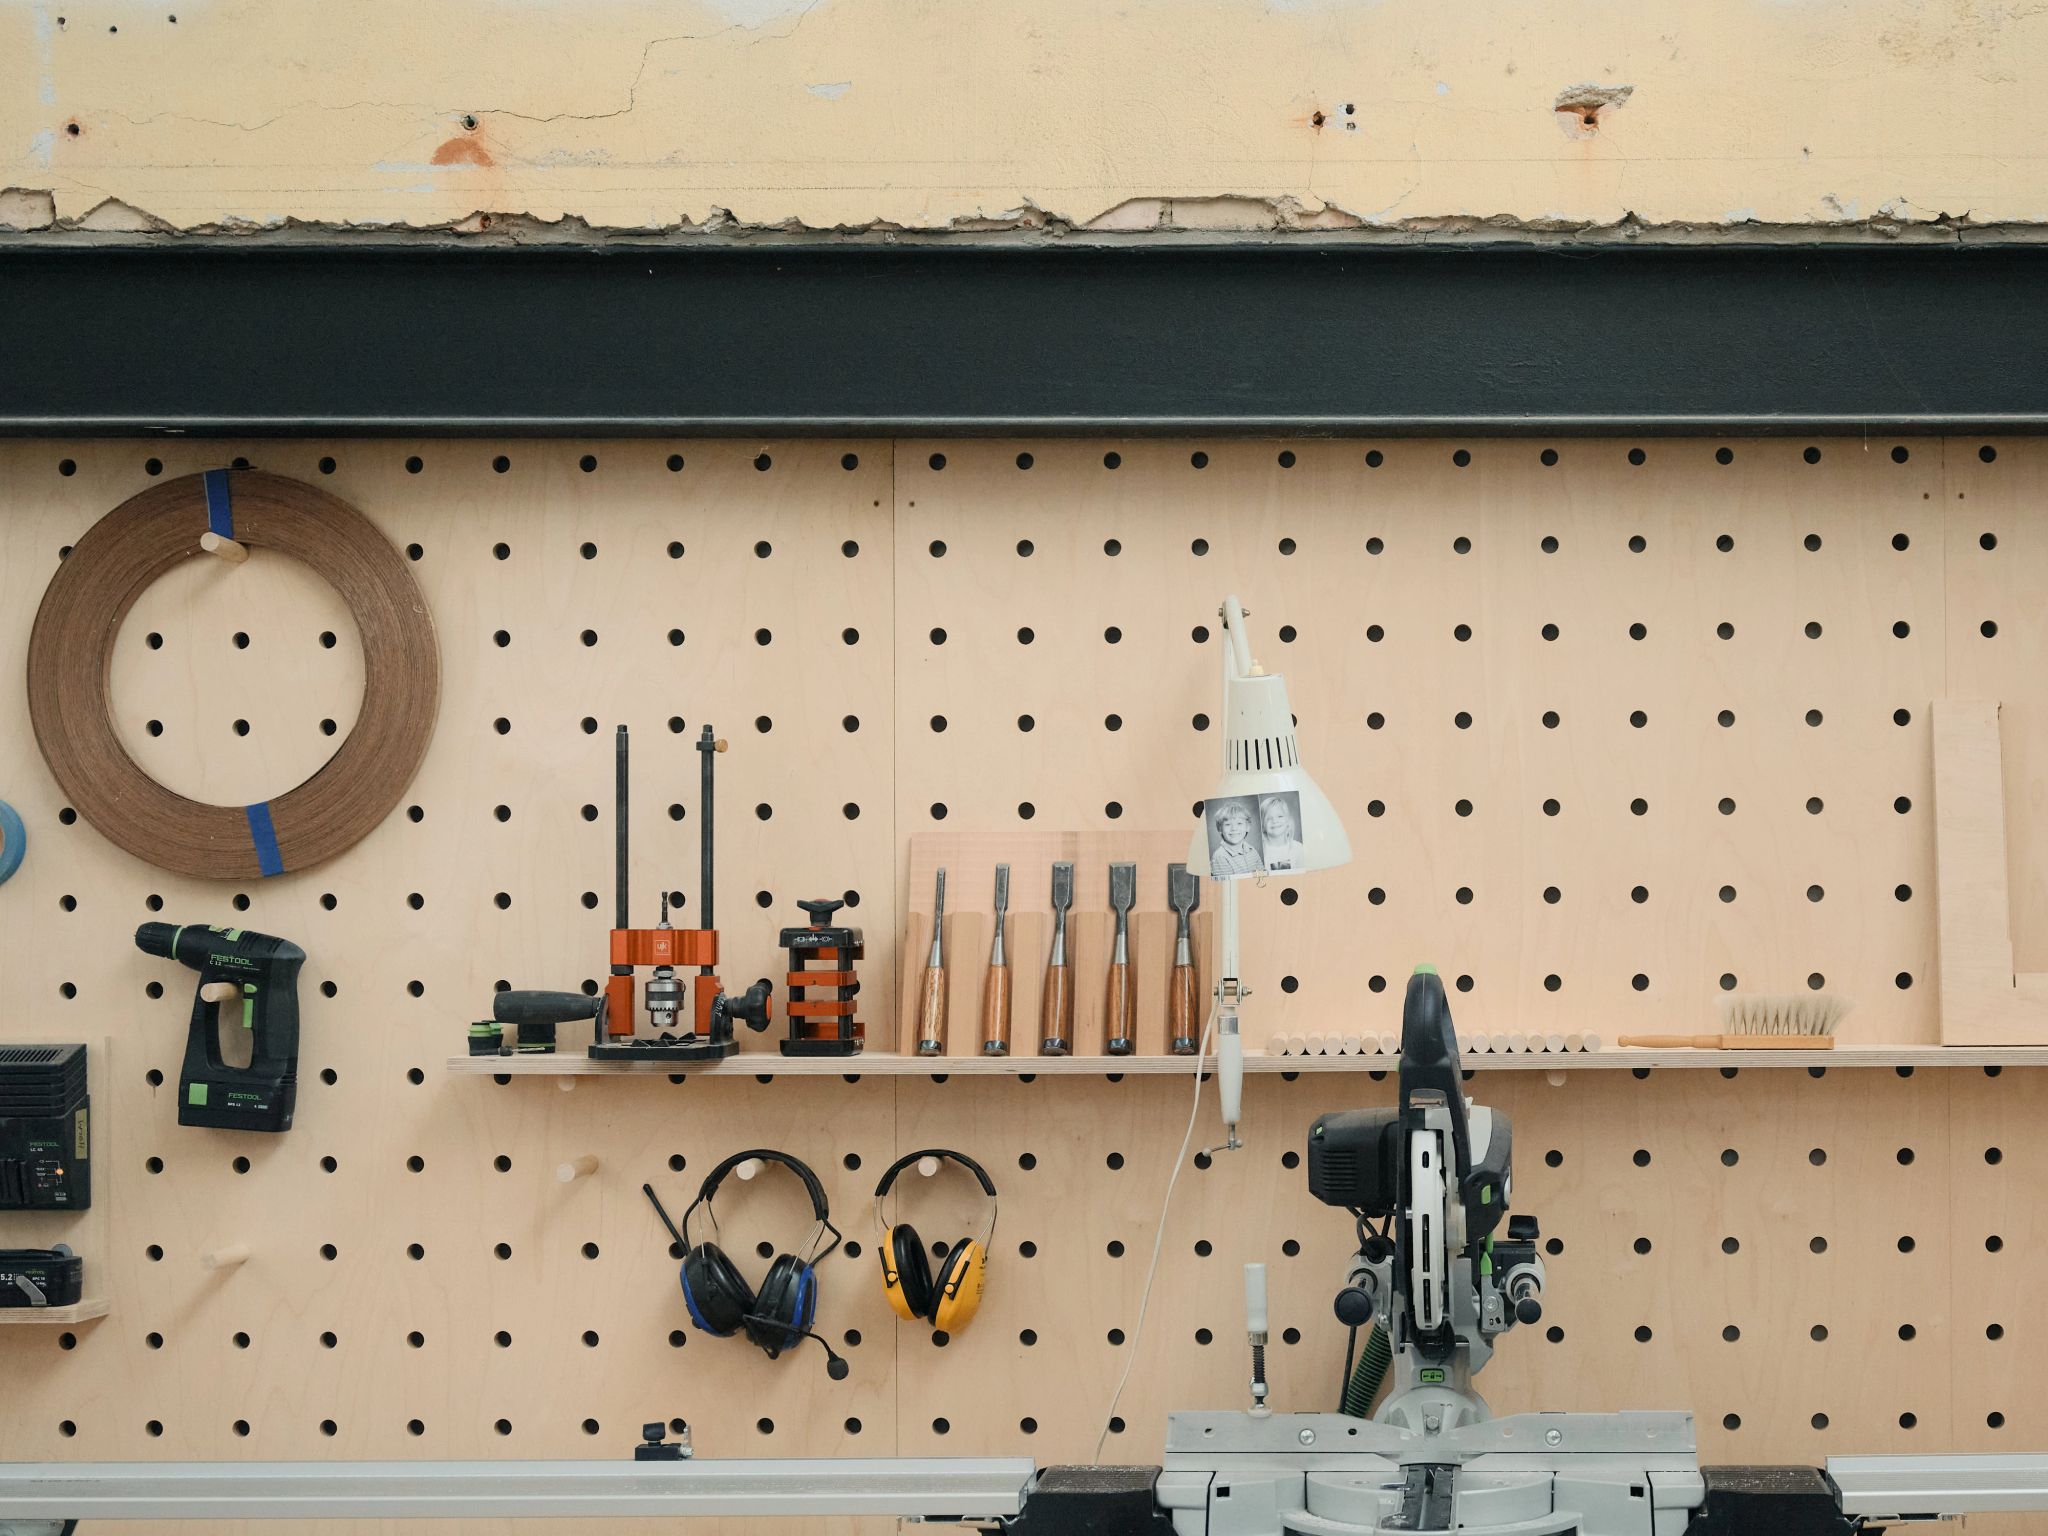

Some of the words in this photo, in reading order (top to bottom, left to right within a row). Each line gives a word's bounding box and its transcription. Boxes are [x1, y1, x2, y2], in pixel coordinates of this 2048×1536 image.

[210, 954, 253, 966] FESTOOL
[228, 1092, 262, 1101] FESTOOL
[0, 1273, 13, 1281] 5.2
